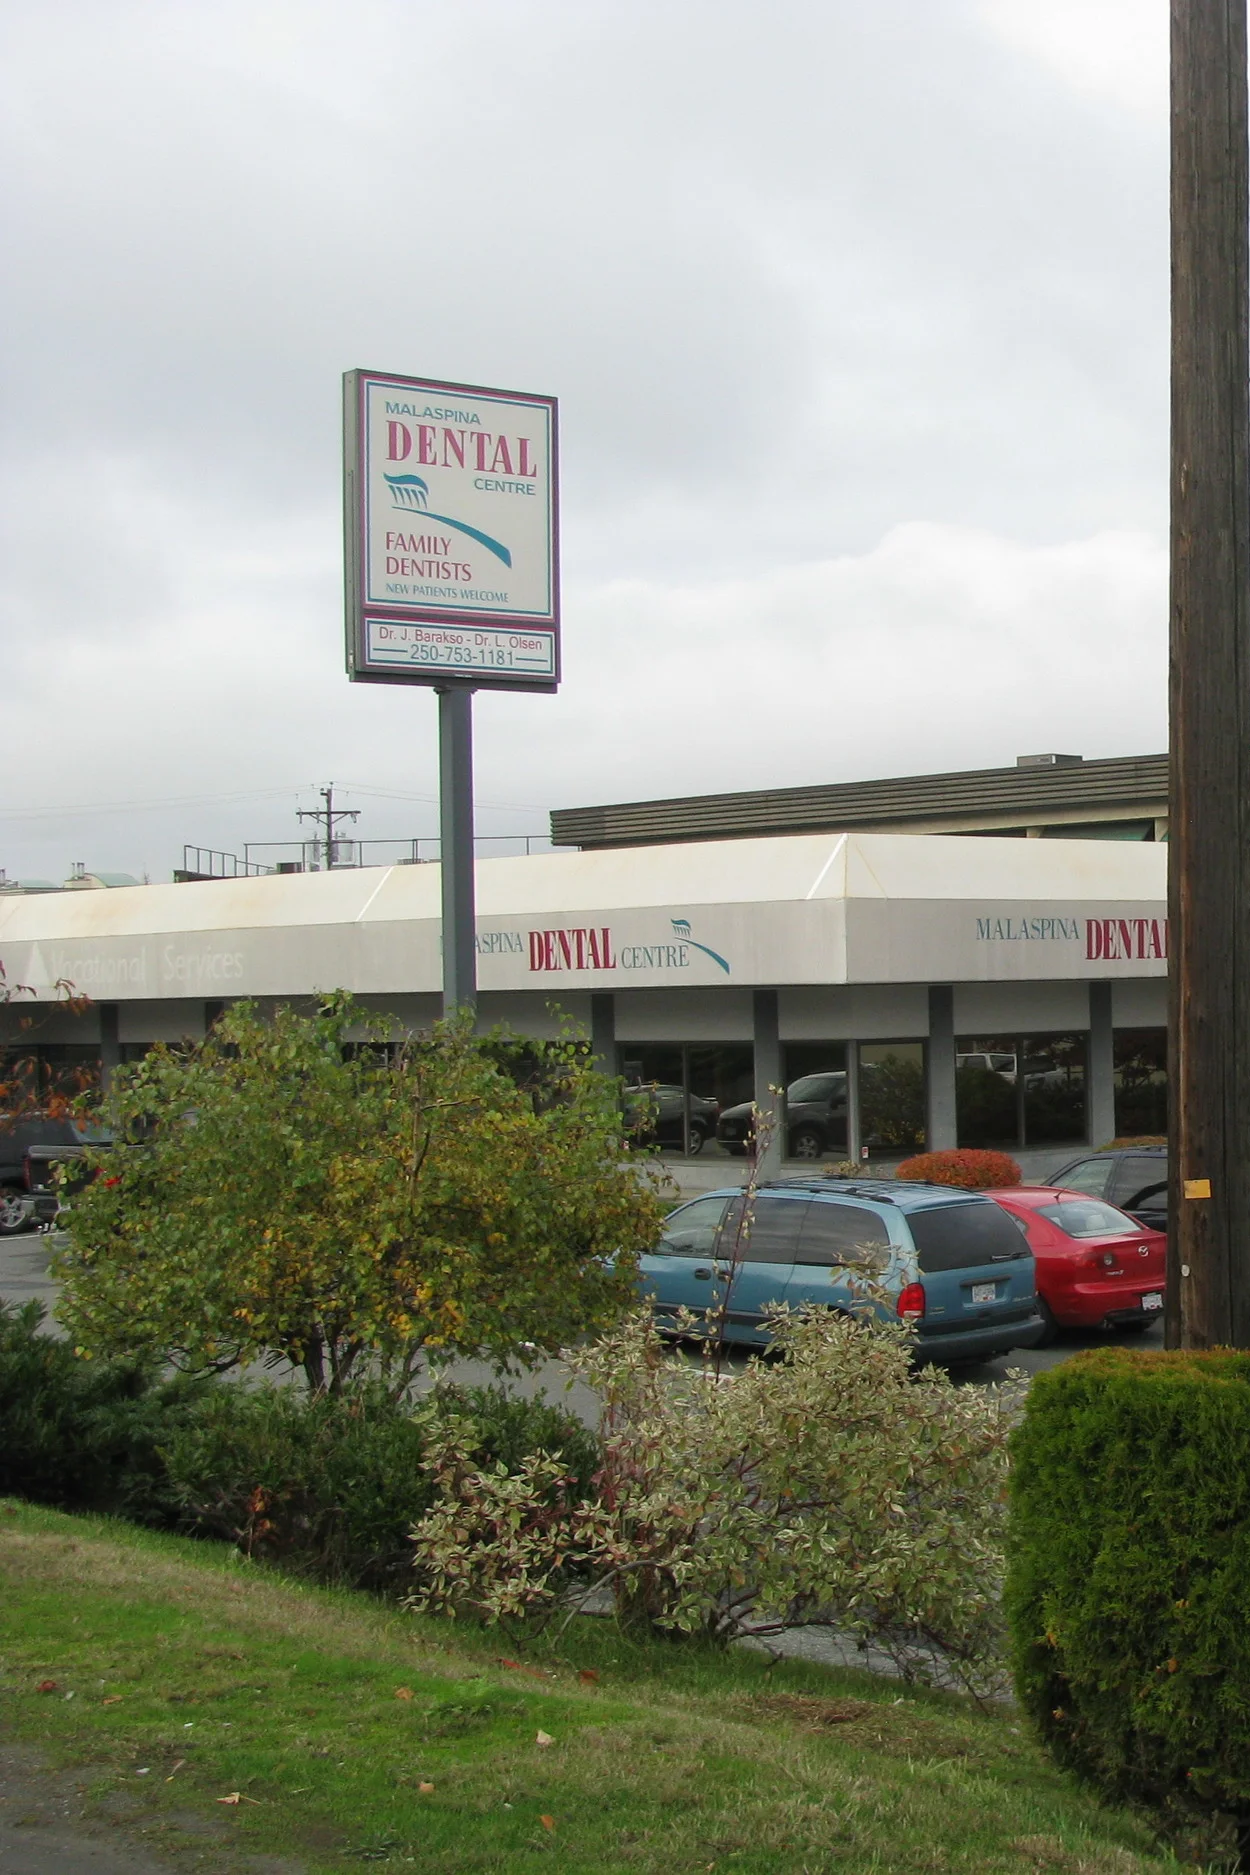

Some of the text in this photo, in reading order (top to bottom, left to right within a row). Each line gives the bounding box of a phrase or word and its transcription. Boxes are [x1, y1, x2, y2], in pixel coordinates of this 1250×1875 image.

[385, 401, 481, 425] MALASPINA
[385, 420, 537, 478] DENTAL
[474, 478, 536, 496] CENTRE
[385, 531, 452, 556] FAMILY
[385, 556, 472, 582] DENTISTS
[386, 583, 509, 603] NEW PATIENTS WELCOME
[379, 626, 396, 640] Dr.
[400, 628, 411, 641] J.
[415, 629, 463, 645] Barakso
[474, 633, 491, 647] Dr.
[495, 635, 505, 648] L.
[509, 636, 542, 650] Olsen
[410, 644, 514, 666] 250-753-1181
[976, 917, 1080, 941] MALASPINA
[528, 927, 617, 971] DENTAL
[621, 945, 690, 970] CENTRE
[163, 944, 244, 981] Services
